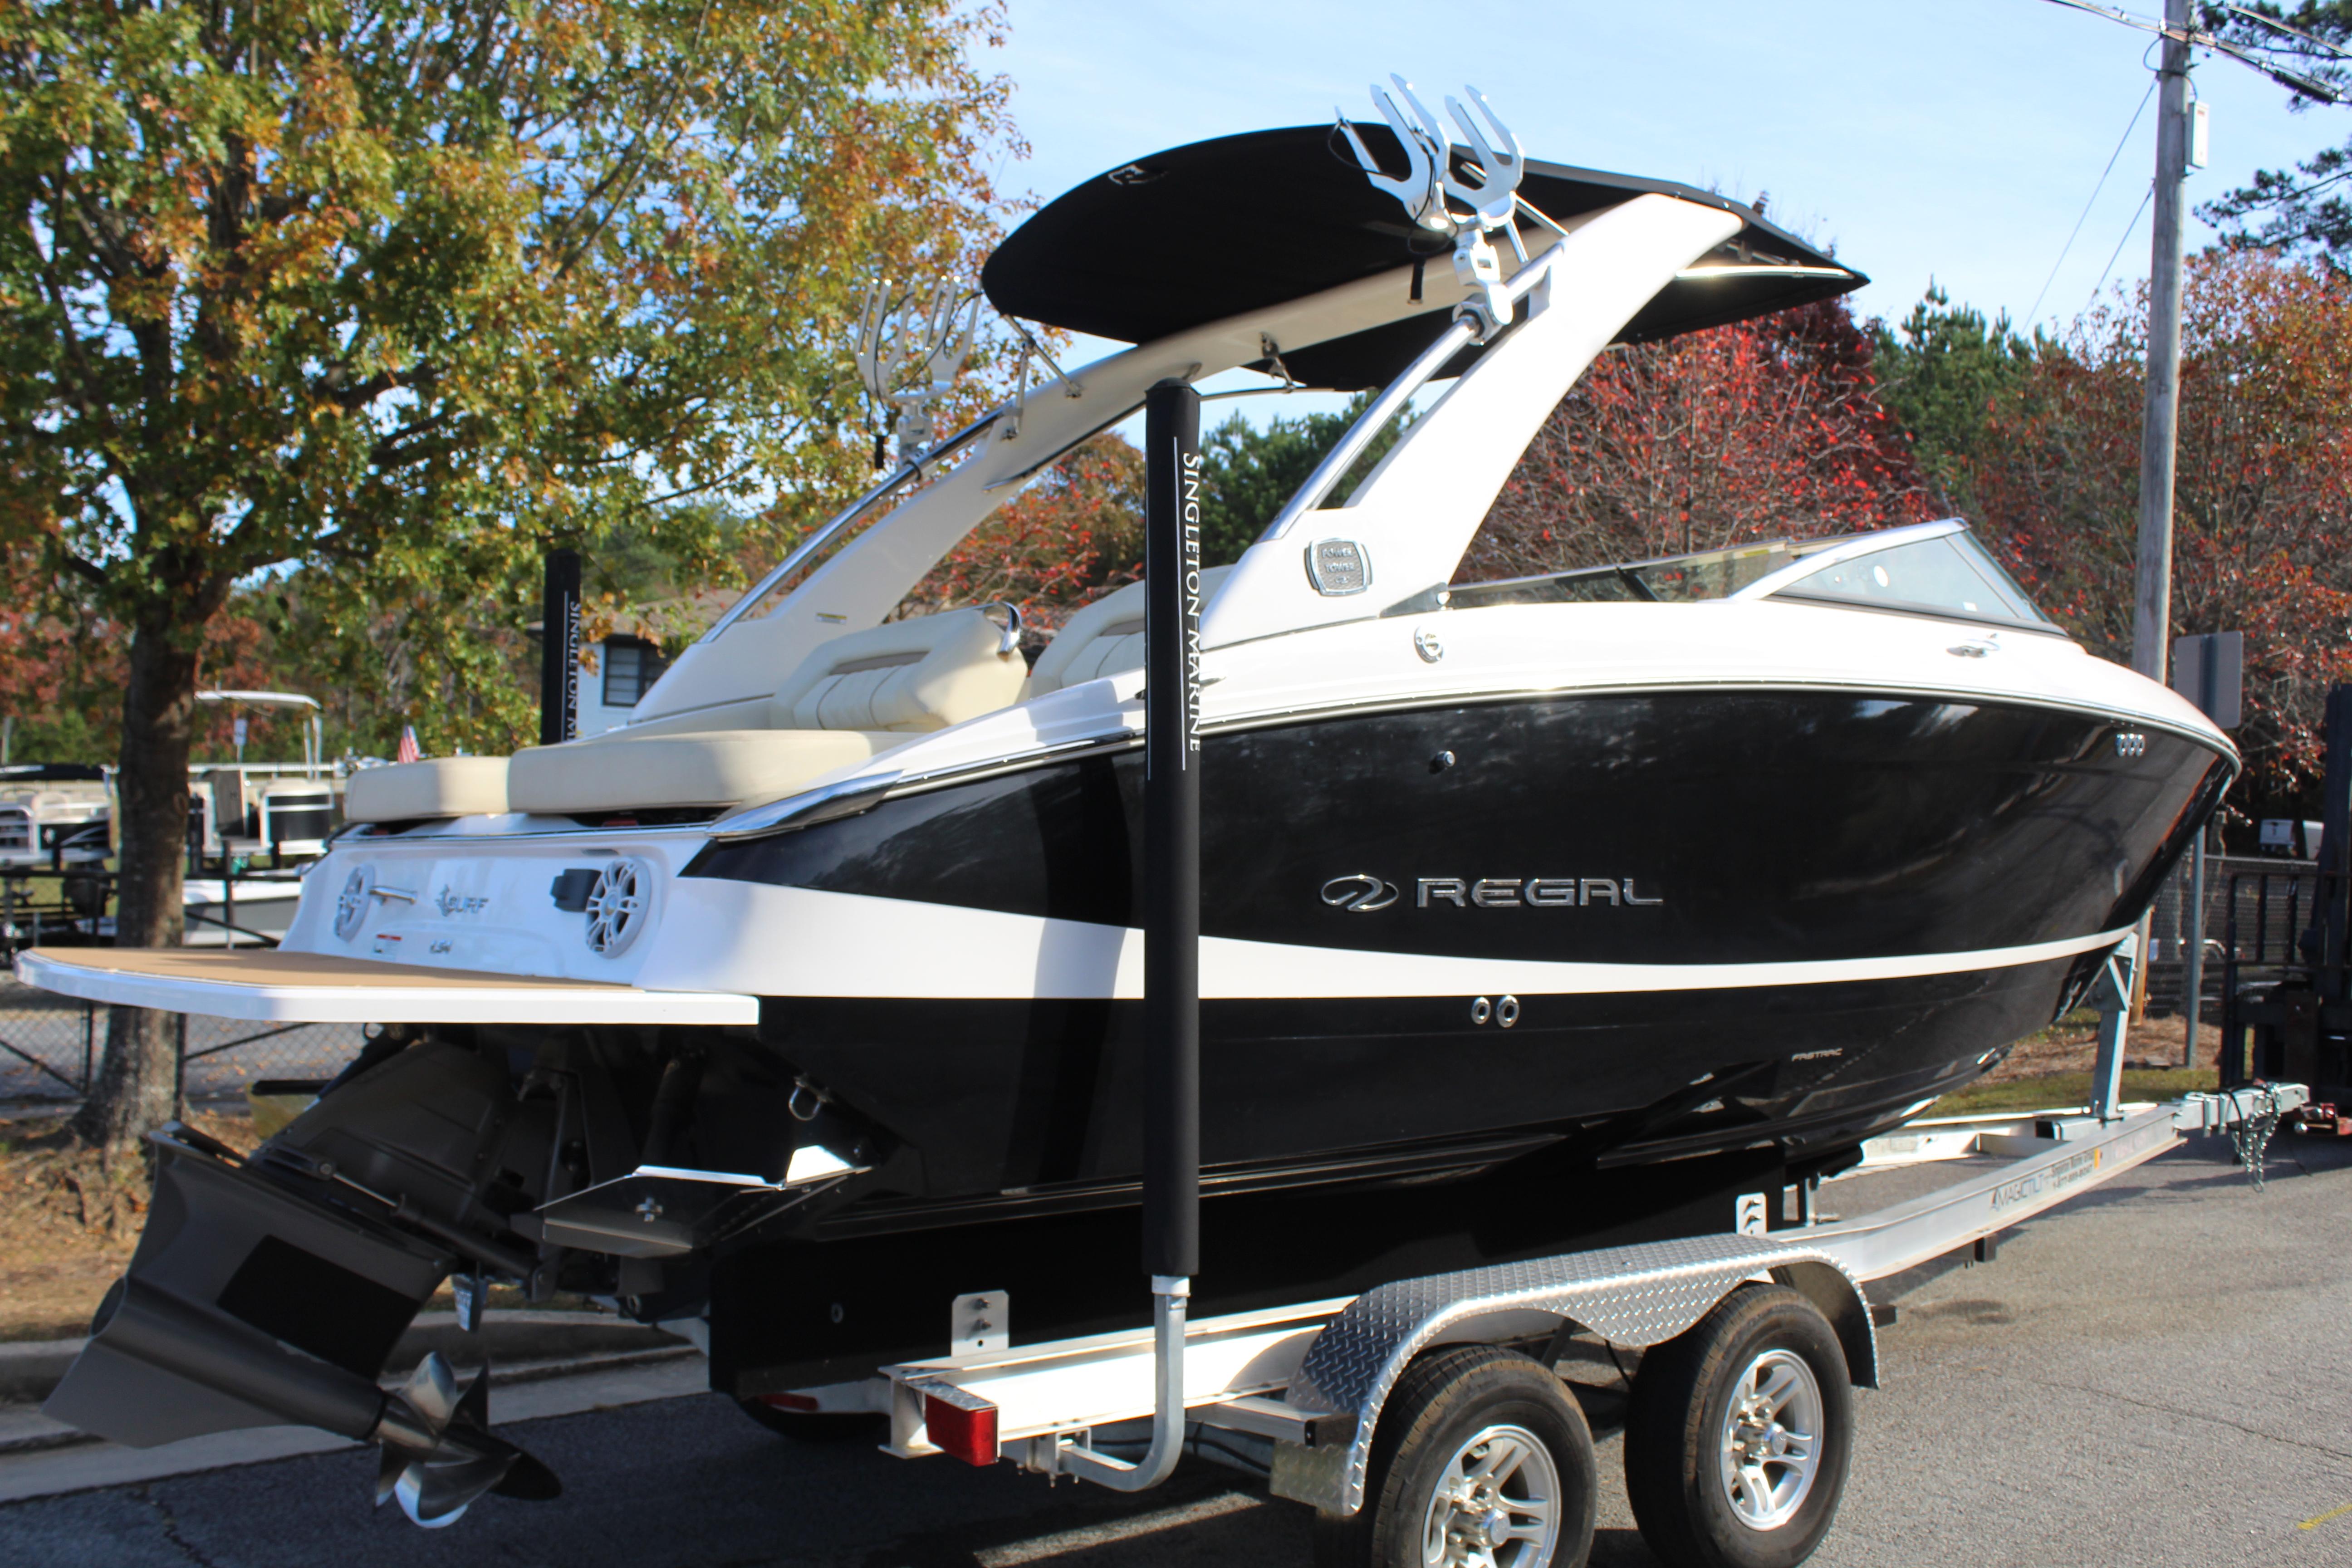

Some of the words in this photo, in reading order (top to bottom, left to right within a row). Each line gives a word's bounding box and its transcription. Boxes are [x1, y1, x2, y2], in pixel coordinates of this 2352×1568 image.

[1183, 452, 1200, 617] SINGLETON
[1321, 548, 1353, 559] POWER
[1324, 563, 1355, 573] TOWER
[568, 601, 581, 710] SINGLETON
[1187, 628, 1200, 752] MARINE
[1417, 878, 1664, 907] REGAL
